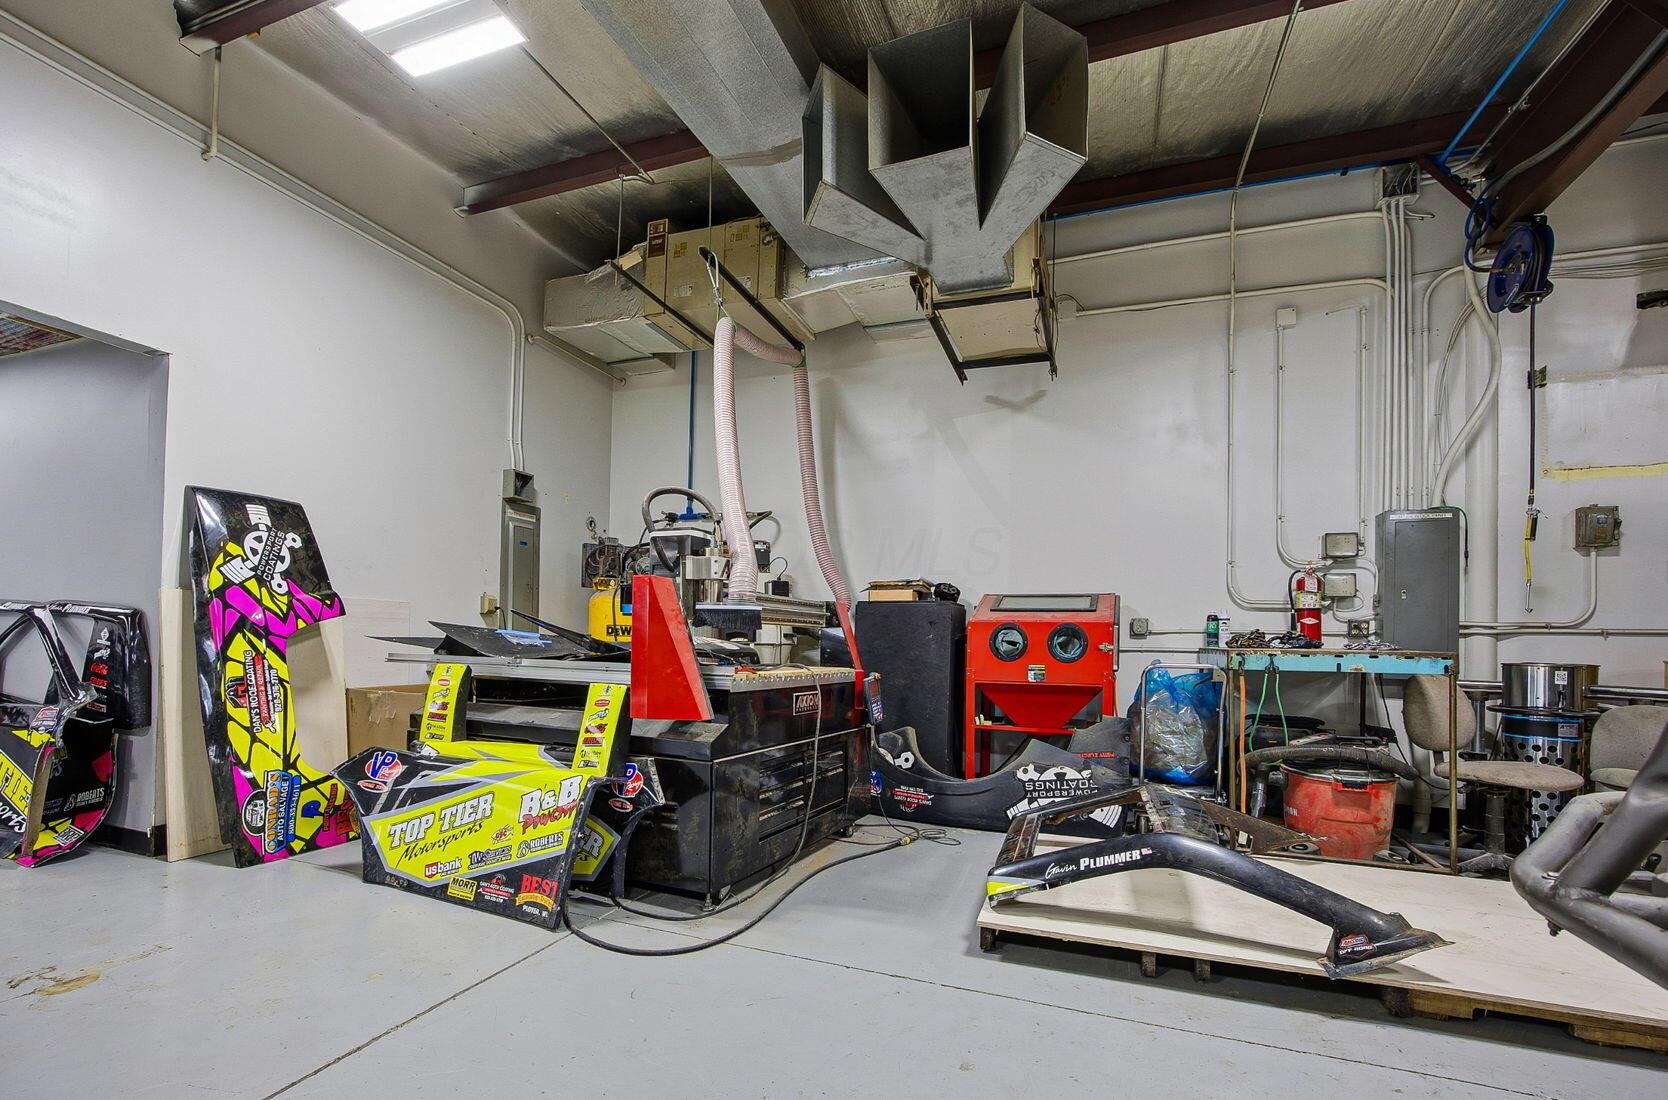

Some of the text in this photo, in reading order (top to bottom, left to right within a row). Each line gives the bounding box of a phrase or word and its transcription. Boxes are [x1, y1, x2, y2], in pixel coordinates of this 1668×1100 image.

[258, 527, 277, 576] POWERSPORT
[263, 530, 285, 581] COATINGS
[244, 650, 262, 733] DAN'S ROOF COATING
[370, 751, 397, 779] VP
[265, 772, 281, 852] CONRAD'S
[277, 780, 289, 841] AUTO SALVAGE
[389, 813, 435, 848] TOP
[440, 793, 494, 832] TIER
[518, 775, 583, 823] B&B
[395, 821, 483, 869] Motorsports
[529, 832, 564, 849] ROBERTS
[1045, 849, 1141, 879] Gavin PLUMMER
[424, 857, 462, 877] usbank
[450, 877, 477, 894] MORR
[520, 873, 559, 901] BEST
